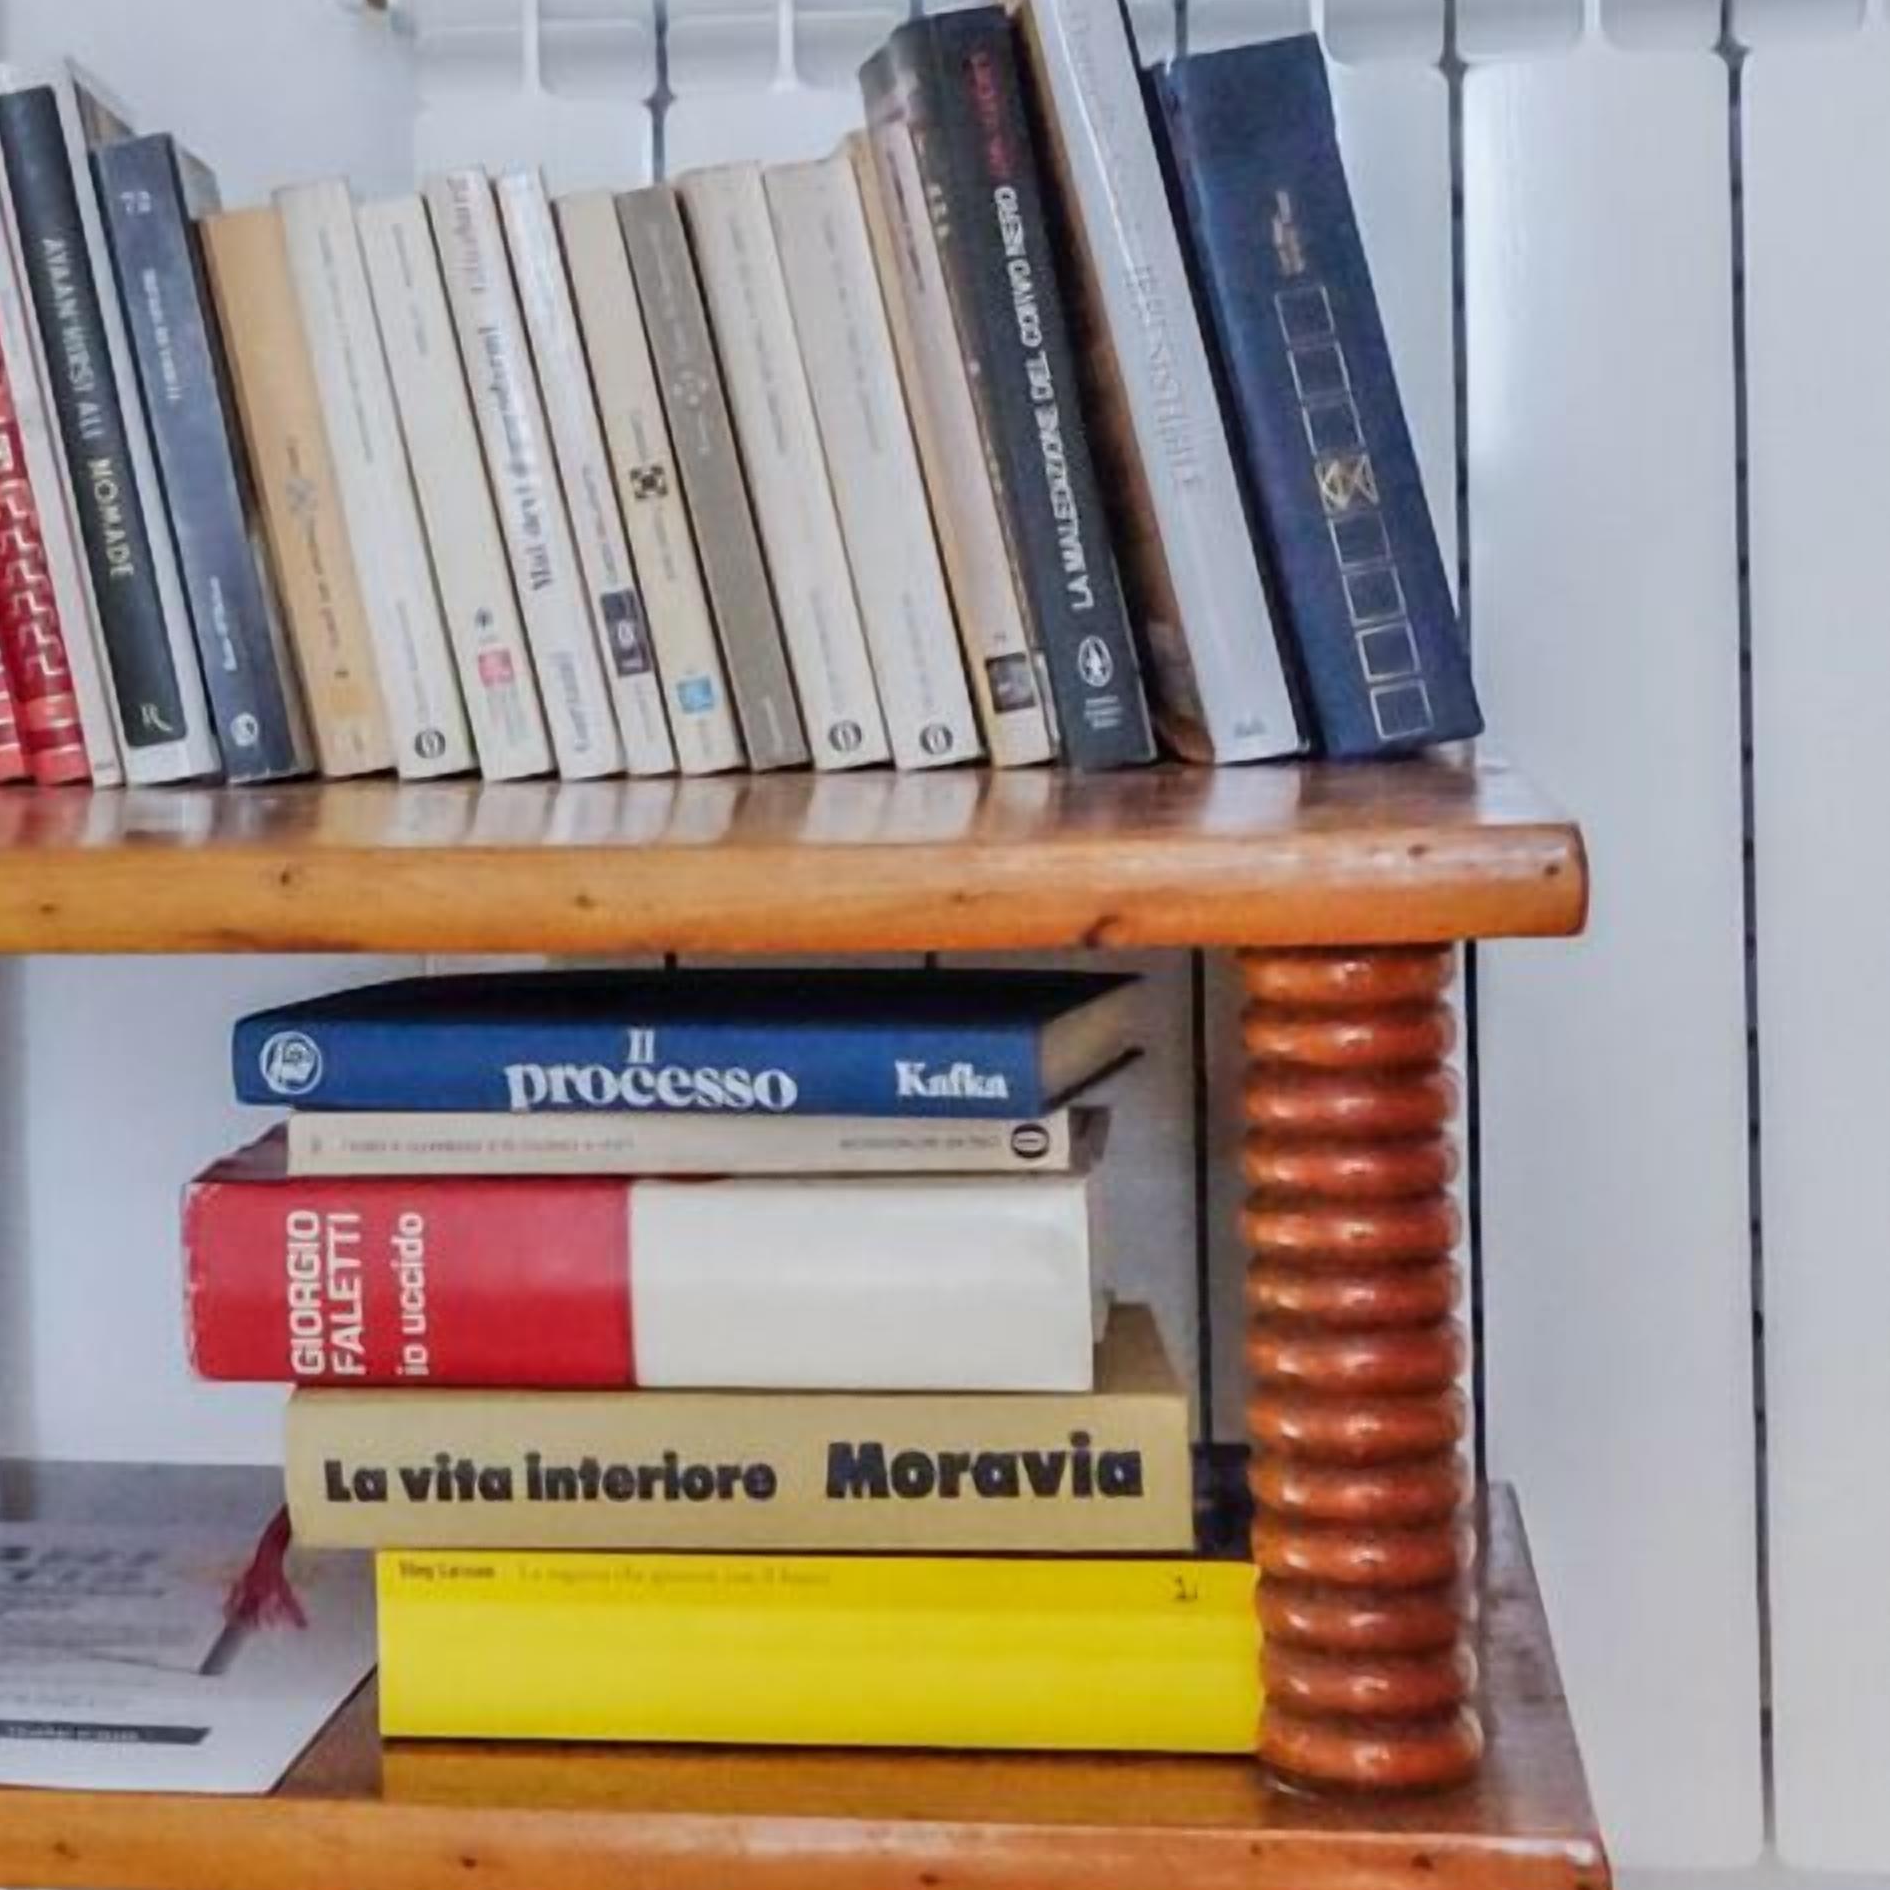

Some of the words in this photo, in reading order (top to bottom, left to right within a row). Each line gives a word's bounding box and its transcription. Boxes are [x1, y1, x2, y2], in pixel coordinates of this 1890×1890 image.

[993, 185, 1027, 258] NERO
[42, 237, 77, 319] AYAAN
[1006, 258, 1043, 348] CORVO
[1025, 350, 1055, 403] DEL
[1035, 404, 1090, 575] MALEDIZIONE
[1069, 572, 1095, 611] LA
[627, 1026, 655, 1064] Il
[895, 1059, 1009, 1100] Kafka
[504, 1060, 799, 1112] processo
[286, 1209, 326, 1375] GIORGIO
[325, 1212, 367, 1376] FALETTI
[389, 1212, 427, 1335] uccido
[394, 1342, 430, 1376] io
[324, 1458, 389, 1503] La
[399, 1451, 514, 1503] vita
[524, 1449, 778, 1503] interiore
[825, 1430, 1144, 1499] Moravia
